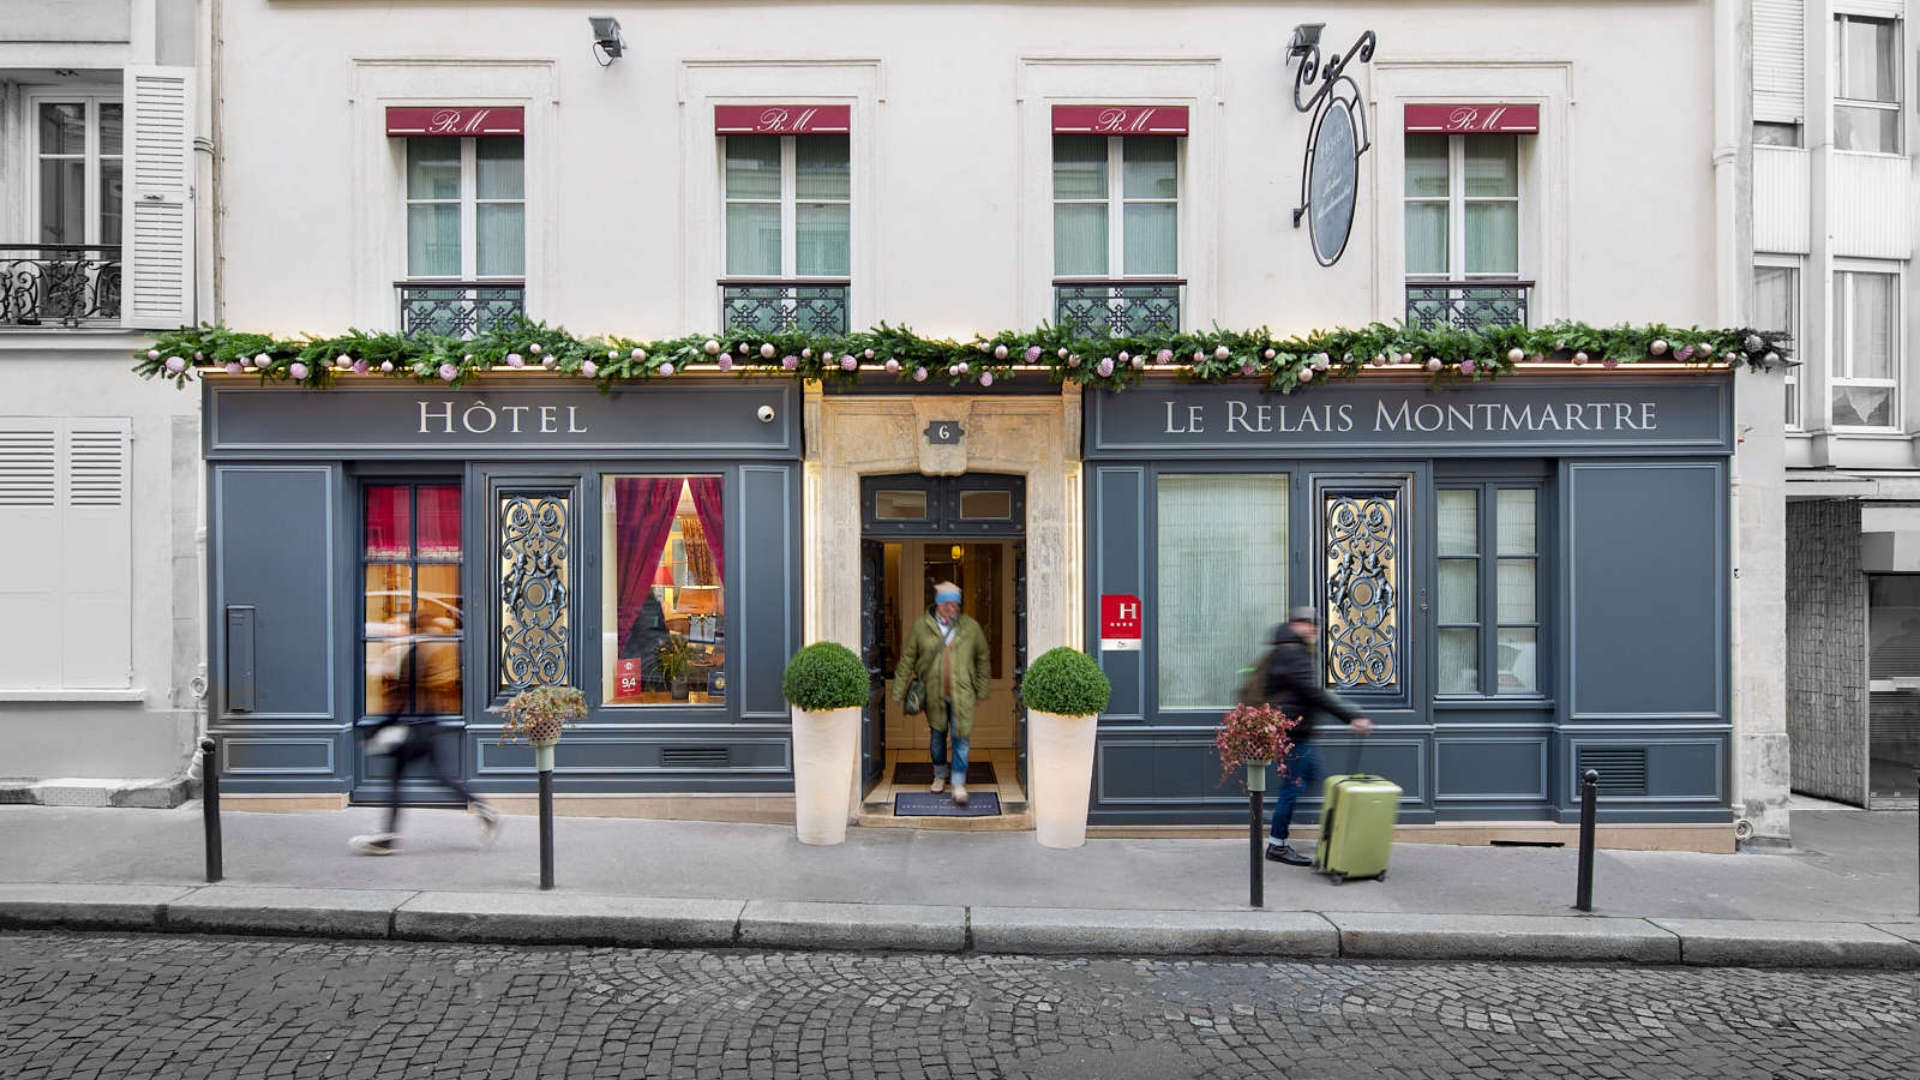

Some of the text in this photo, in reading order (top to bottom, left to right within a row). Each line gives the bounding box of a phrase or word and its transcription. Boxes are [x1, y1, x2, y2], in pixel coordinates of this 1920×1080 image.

[417, 400, 588, 433] HÔTEL
[1164, 399, 1658, 433] LE RELAIS MONTMARTRE
[939, 424, 950, 439] 6
[1120, 603, 1137, 620] H
